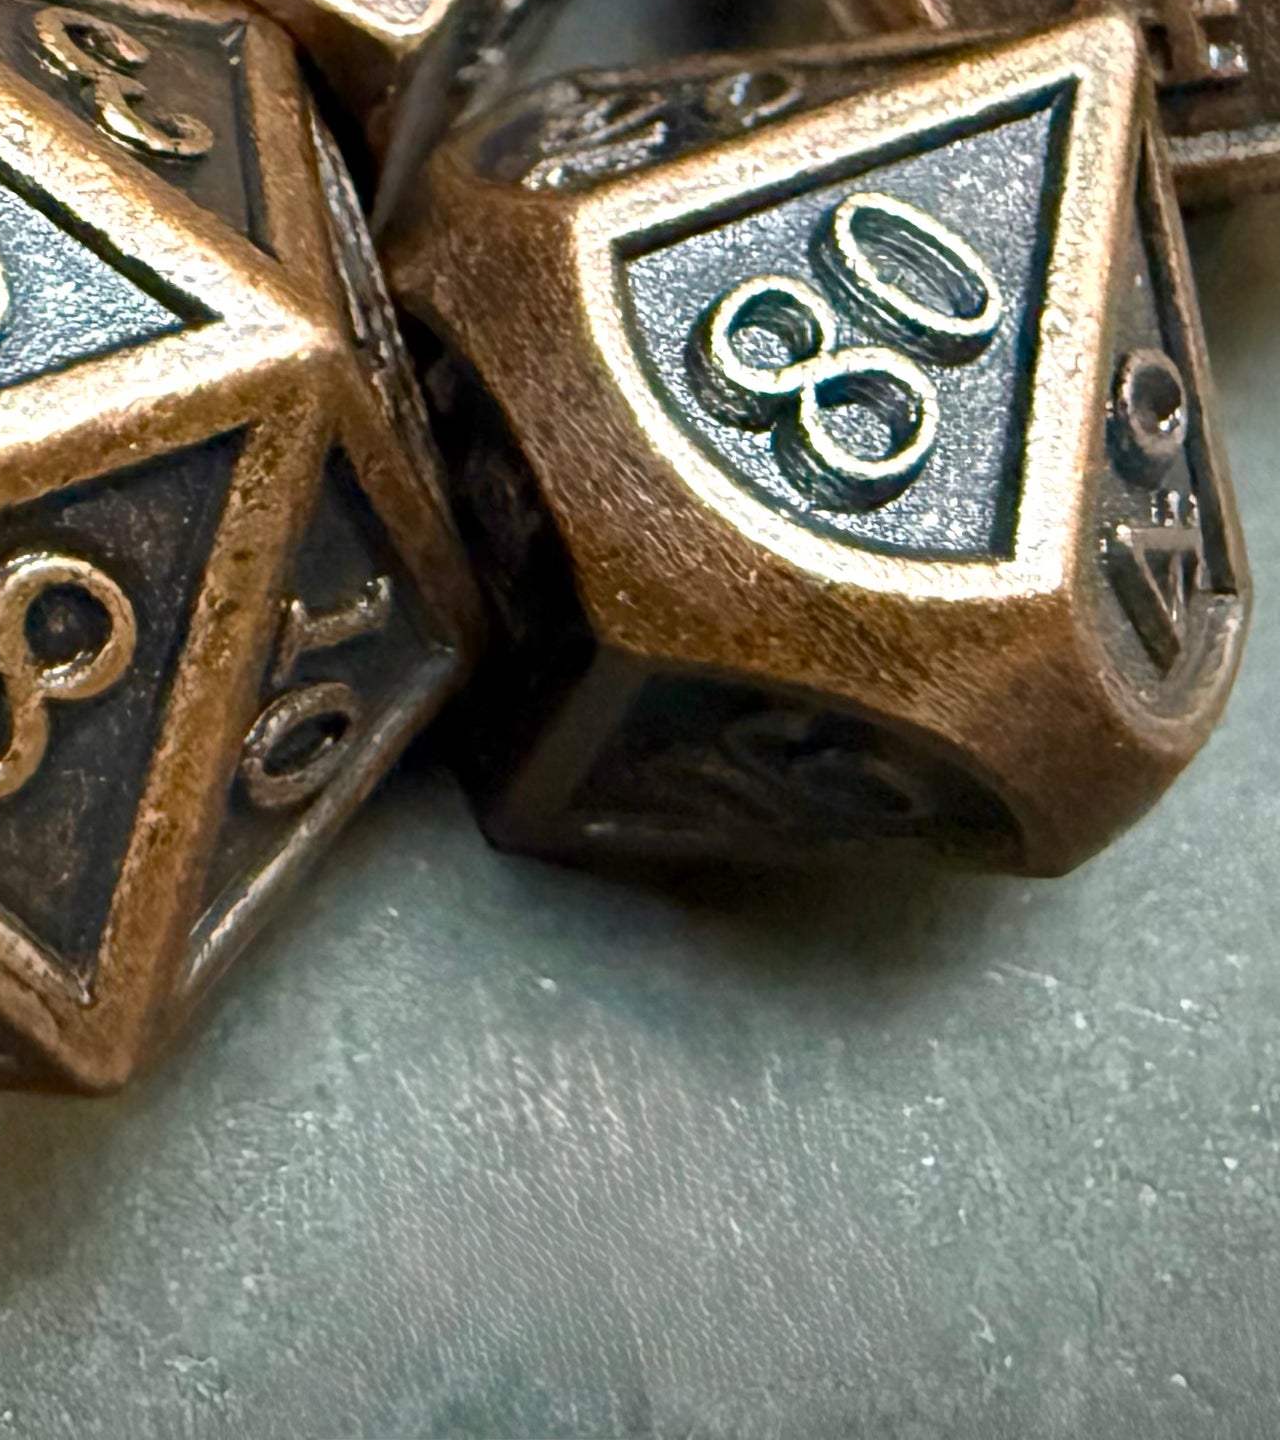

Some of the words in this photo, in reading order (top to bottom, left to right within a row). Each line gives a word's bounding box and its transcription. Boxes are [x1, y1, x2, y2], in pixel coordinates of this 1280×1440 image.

[32, 8, 214, 158] 3
[696, 190, 1004, 490] 80
[242, 574, 393, 810] 10
